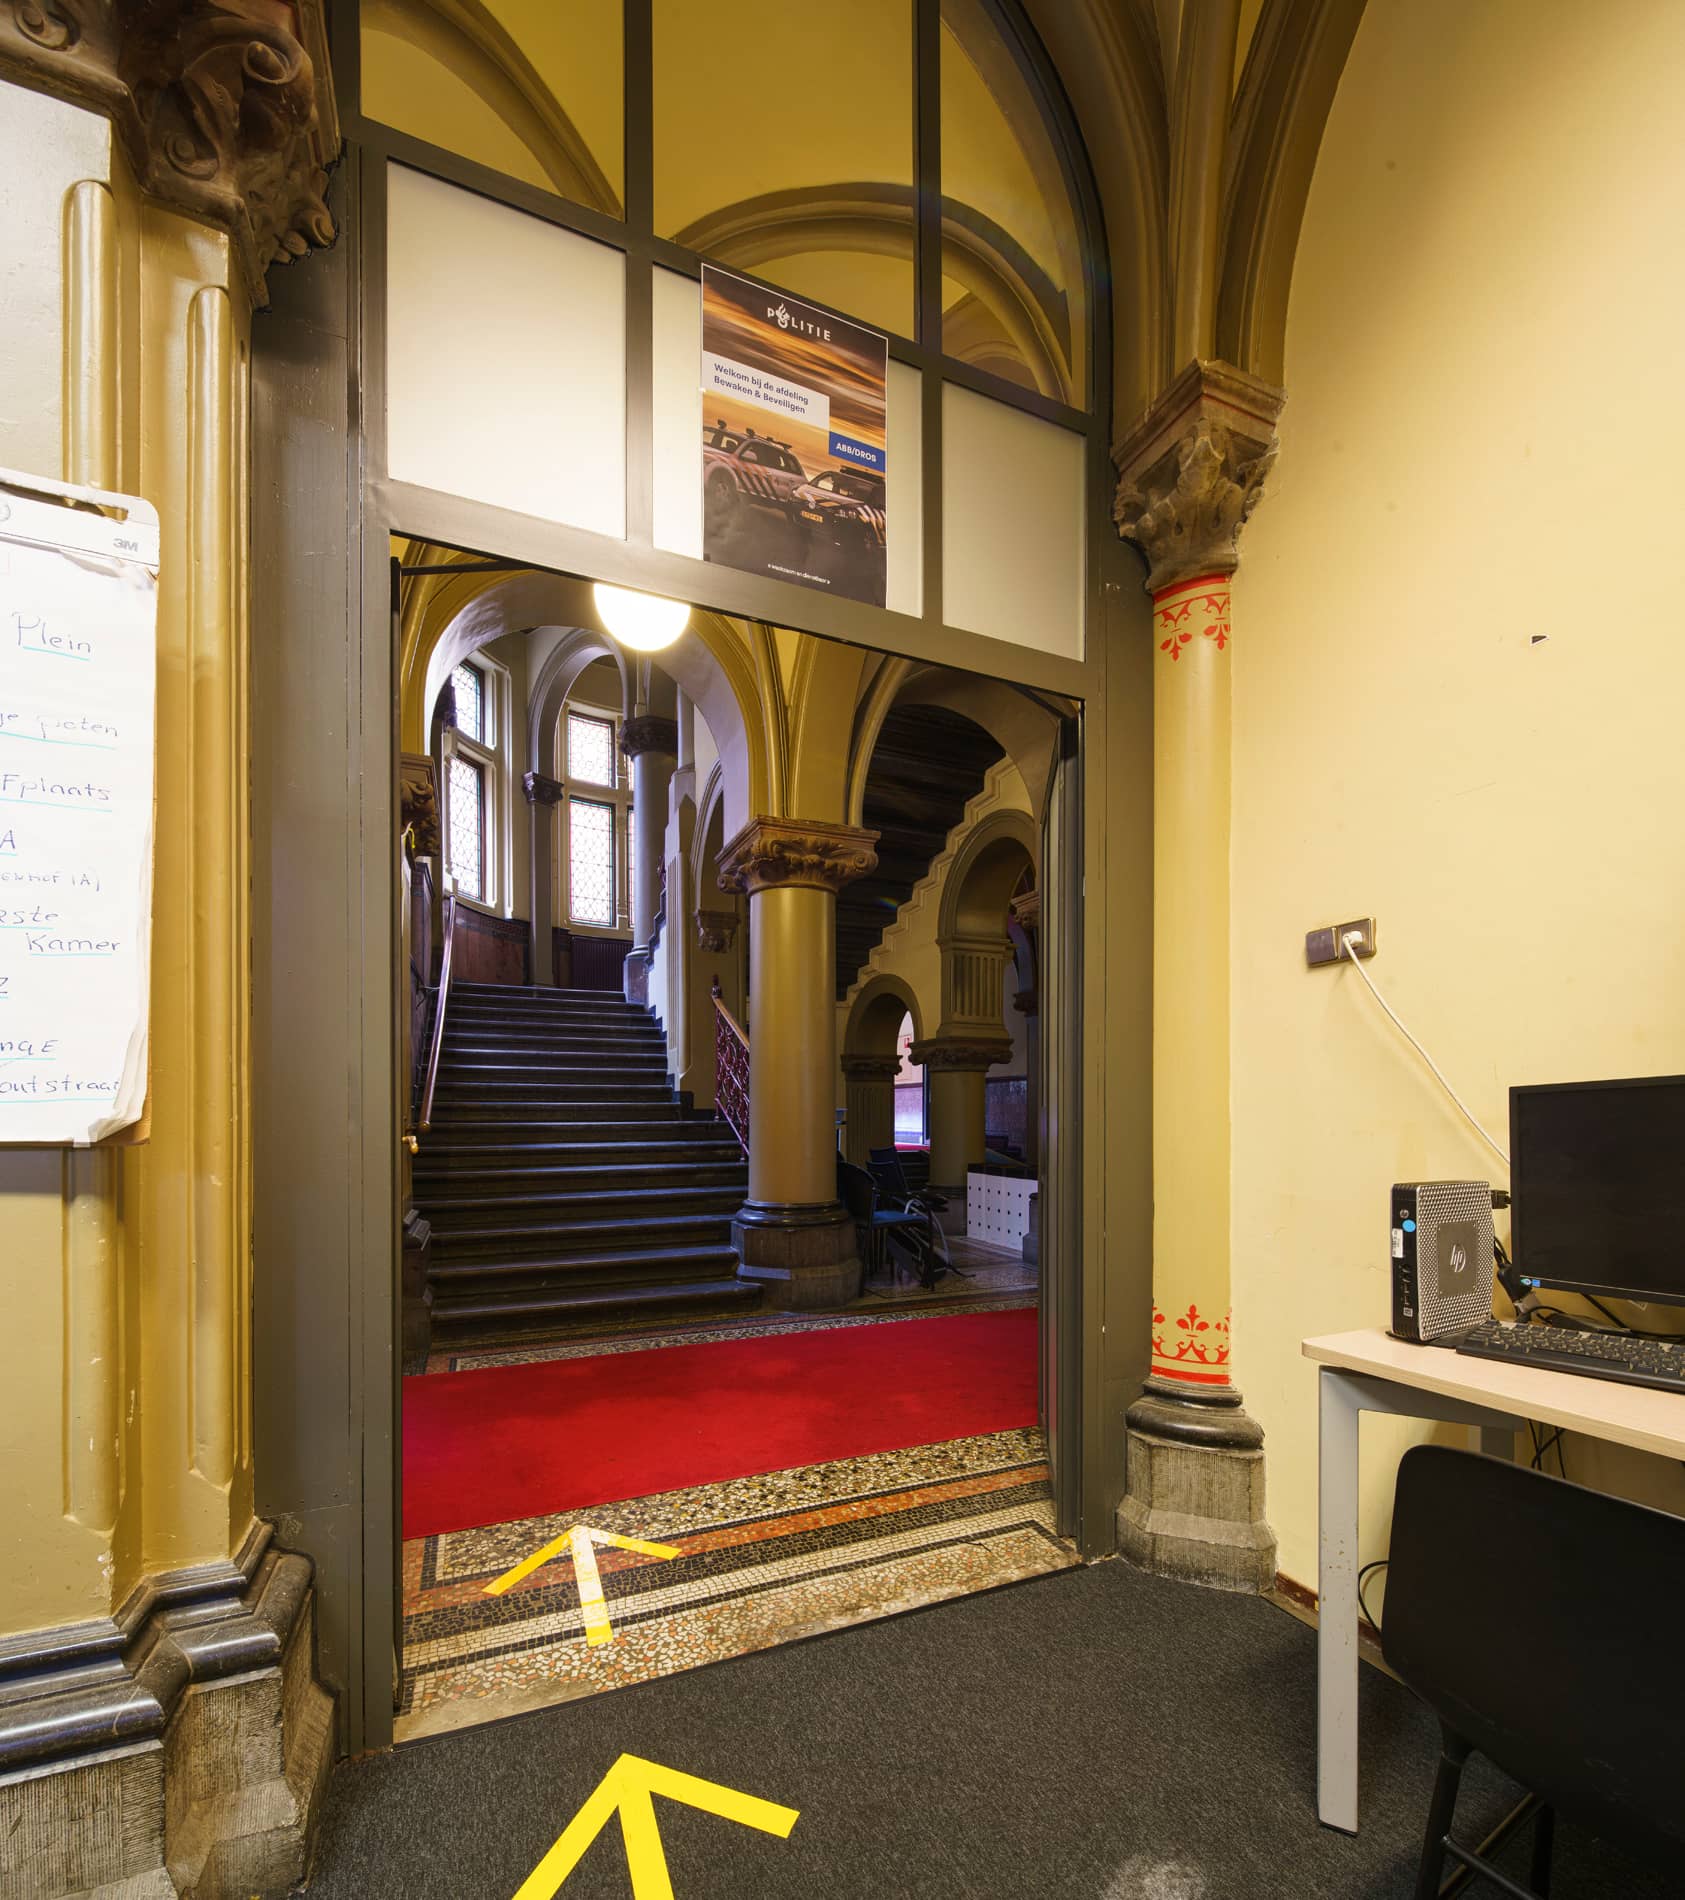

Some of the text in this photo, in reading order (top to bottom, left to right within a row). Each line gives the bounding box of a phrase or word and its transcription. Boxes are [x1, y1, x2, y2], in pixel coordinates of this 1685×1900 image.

[767, 303, 831, 341] POLITIE
[714, 363, 809, 406] Welkom bij de afdeling
[714, 375, 806, 414] Bewaken & Beveiligen
[113, 538, 139, 552] 3M
[11, 611, 91, 653] Plein
[26, 932, 120, 952] Kamer
[1449, 1244, 1466, 1273] hp
